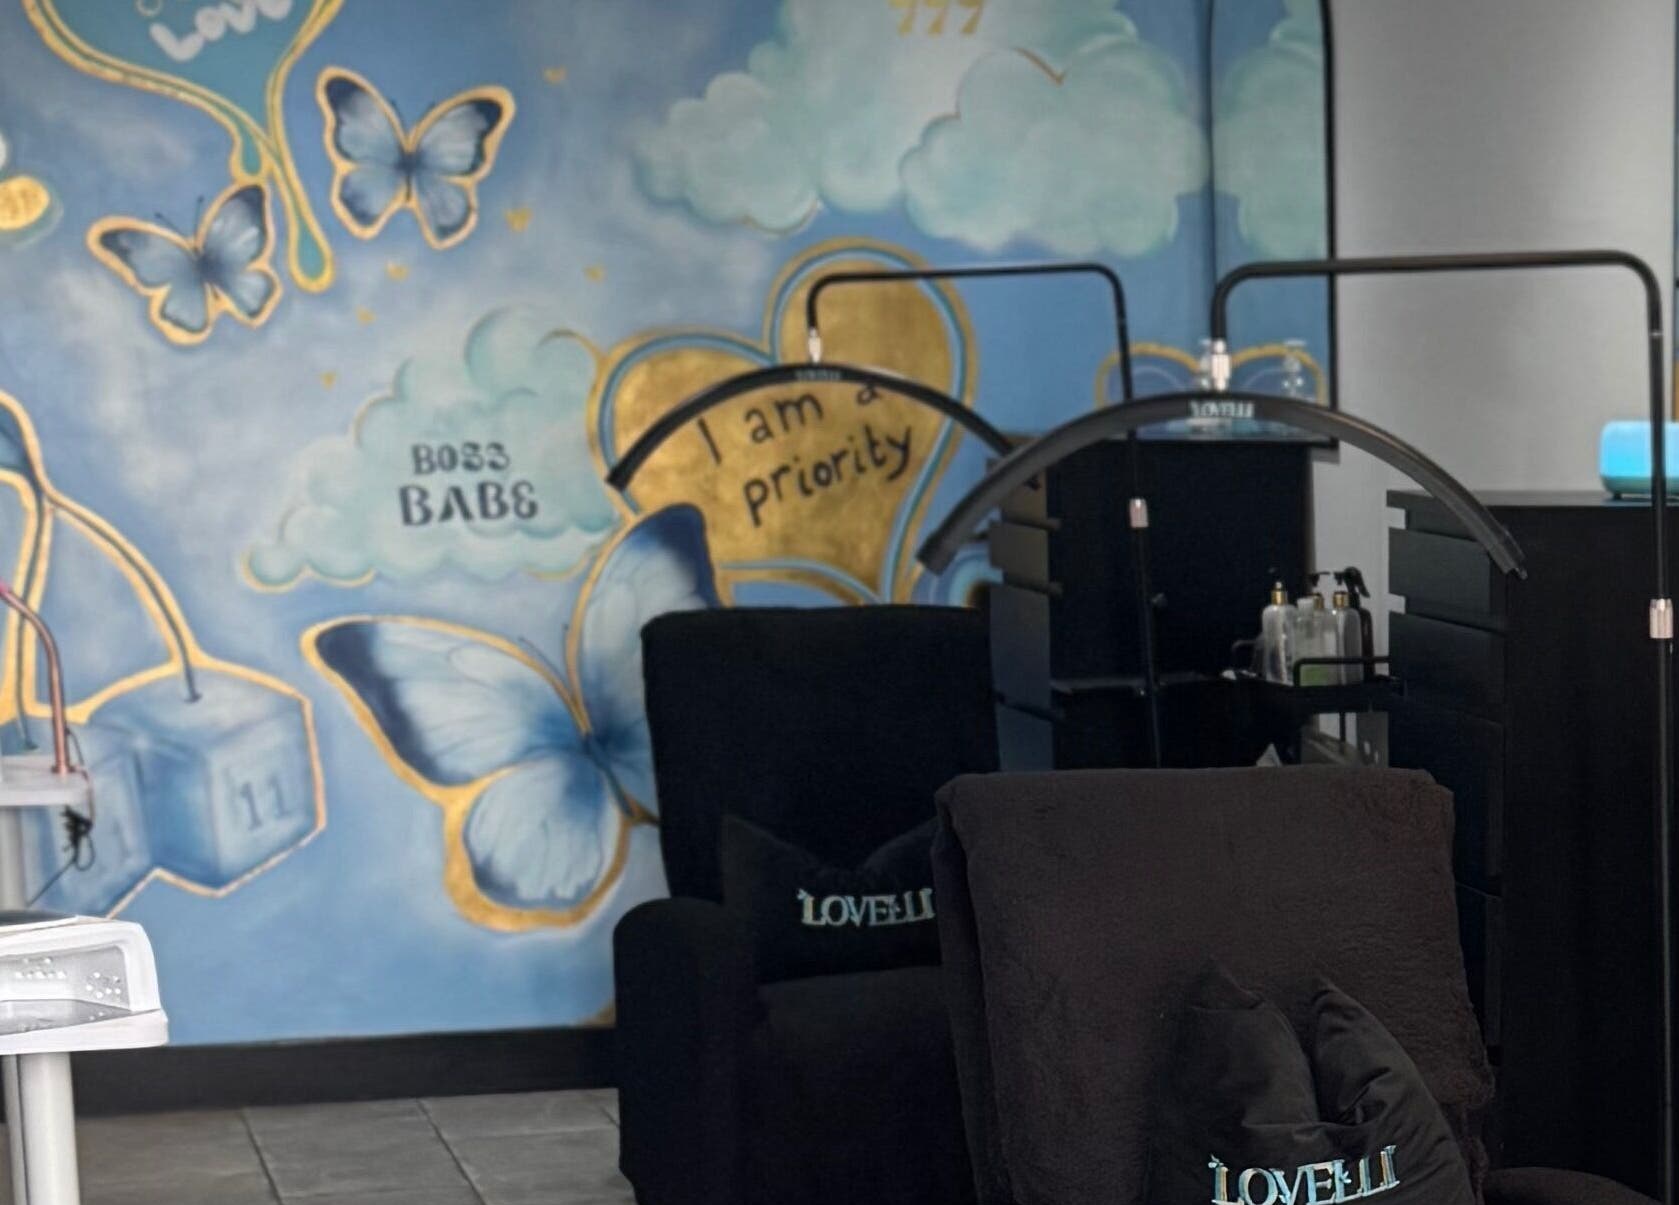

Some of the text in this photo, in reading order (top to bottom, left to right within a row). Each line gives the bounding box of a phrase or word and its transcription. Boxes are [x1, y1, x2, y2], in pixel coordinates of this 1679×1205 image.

[697, 415, 722, 466] I
[745, 393, 824, 443] am
[411, 440, 511, 475] BOSS
[743, 424, 912, 527] priority
[399, 480, 538, 526] BABE
[796, 887, 936, 927] LOVELLI
